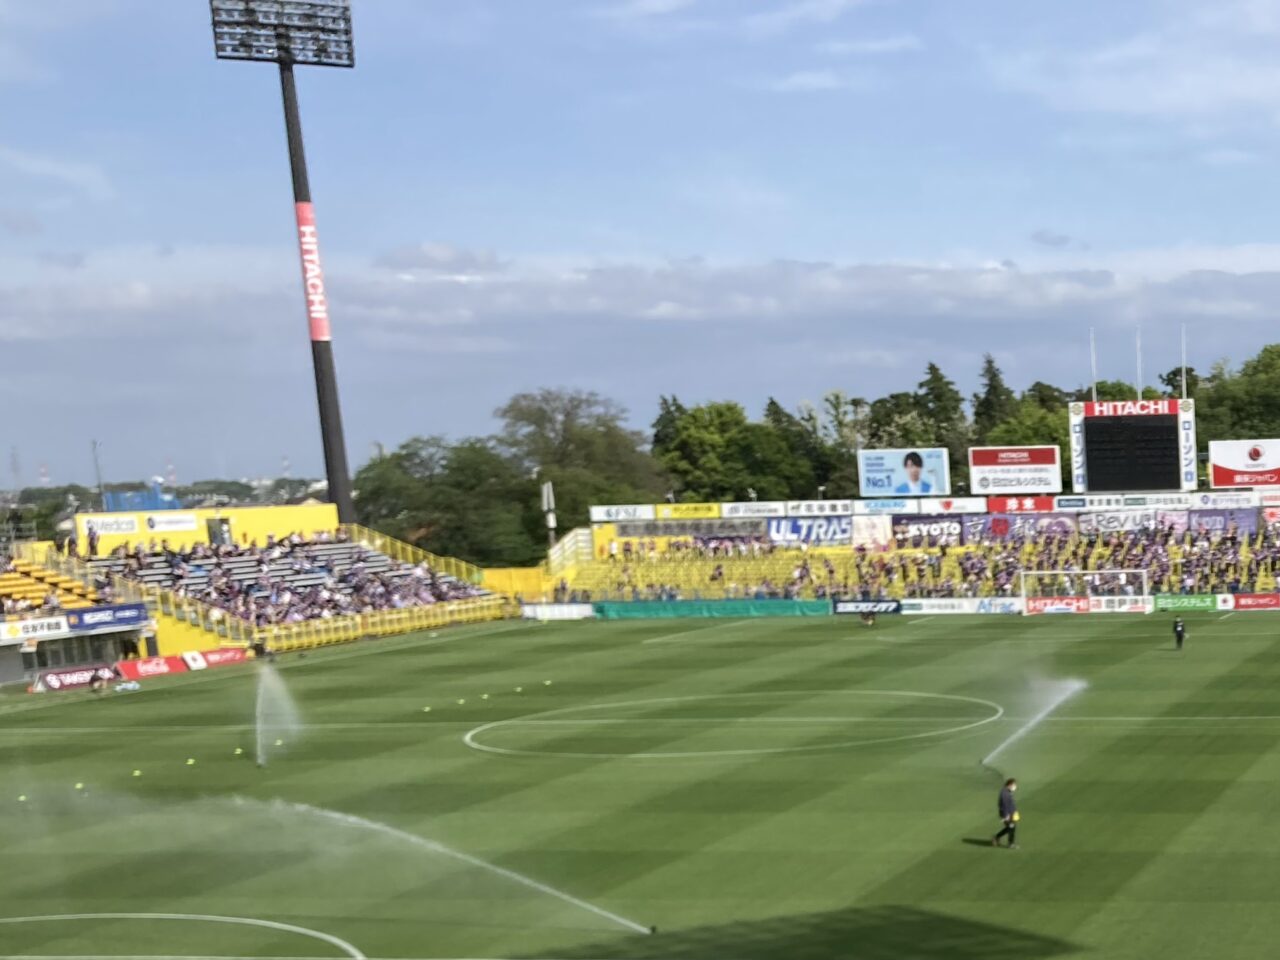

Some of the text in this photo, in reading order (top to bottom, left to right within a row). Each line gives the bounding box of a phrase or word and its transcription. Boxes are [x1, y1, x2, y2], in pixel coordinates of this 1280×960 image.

[300, 224, 328, 318] HITACHI
[1095, 401, 1169, 416] HITACHI
[769, 518, 851, 541] ULTRAS
[907, 521, 961, 537] KYOTO
[1027, 597, 1089, 612] HITACHI
